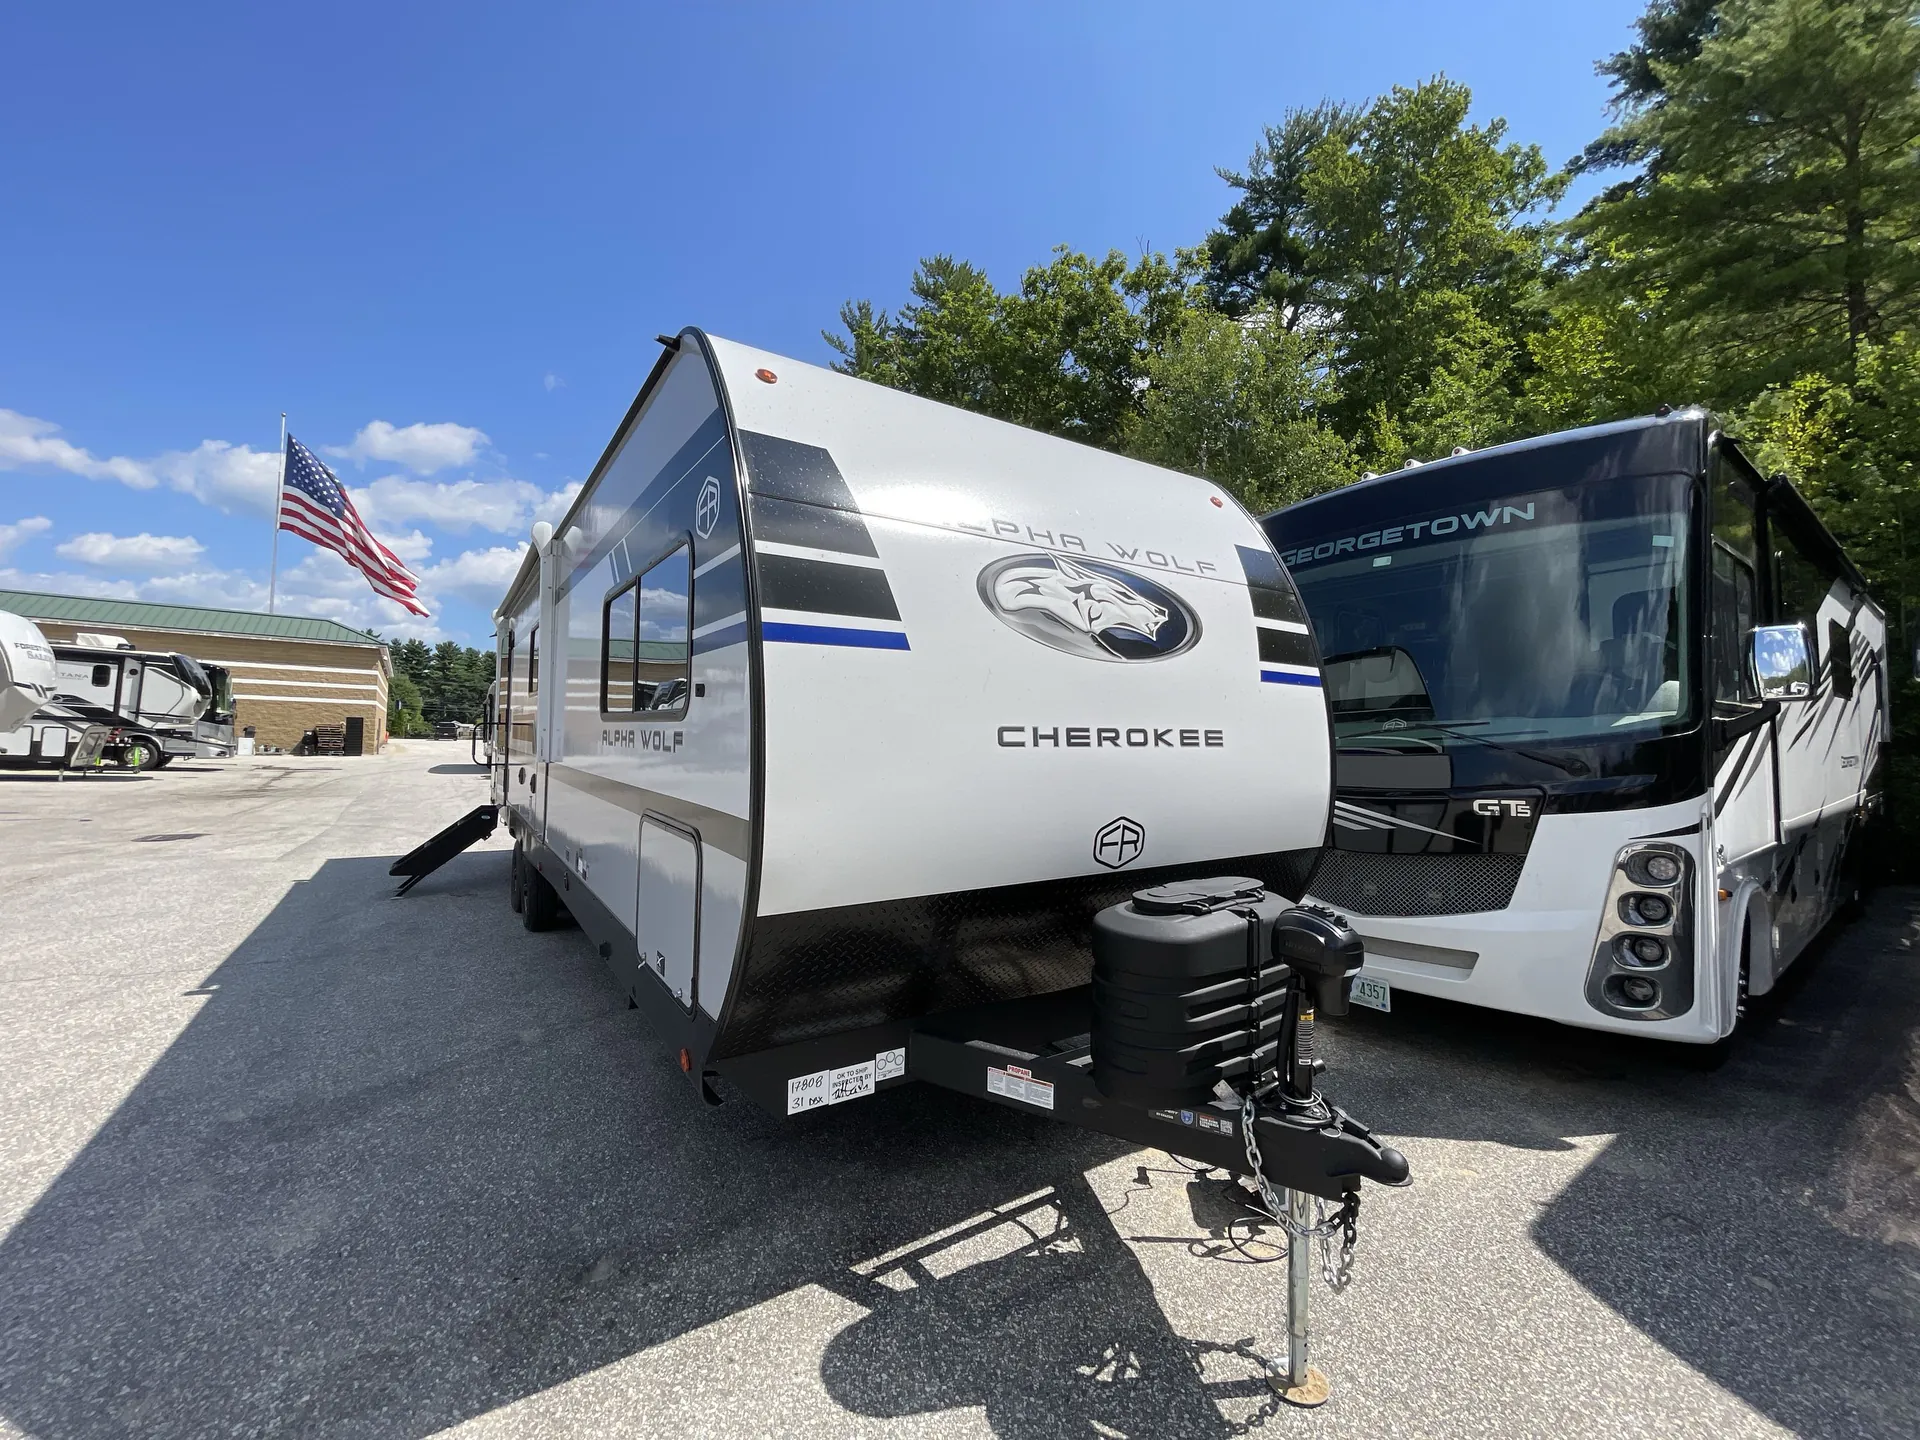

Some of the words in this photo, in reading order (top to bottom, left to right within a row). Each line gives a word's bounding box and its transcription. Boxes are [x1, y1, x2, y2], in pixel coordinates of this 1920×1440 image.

[1279, 502, 1534, 568] GEORGETOWN
[1106, 542, 1217, 573] WOLF
[602, 729, 635, 749] ALPHA
[641, 729, 684, 754] WOLF
[997, 726, 1224, 748] CHEROKEE
[1360, 981, 1386, 1002] 4357
[836, 1072, 846, 1080] OK
[855, 1067, 868, 1075] SHIP
